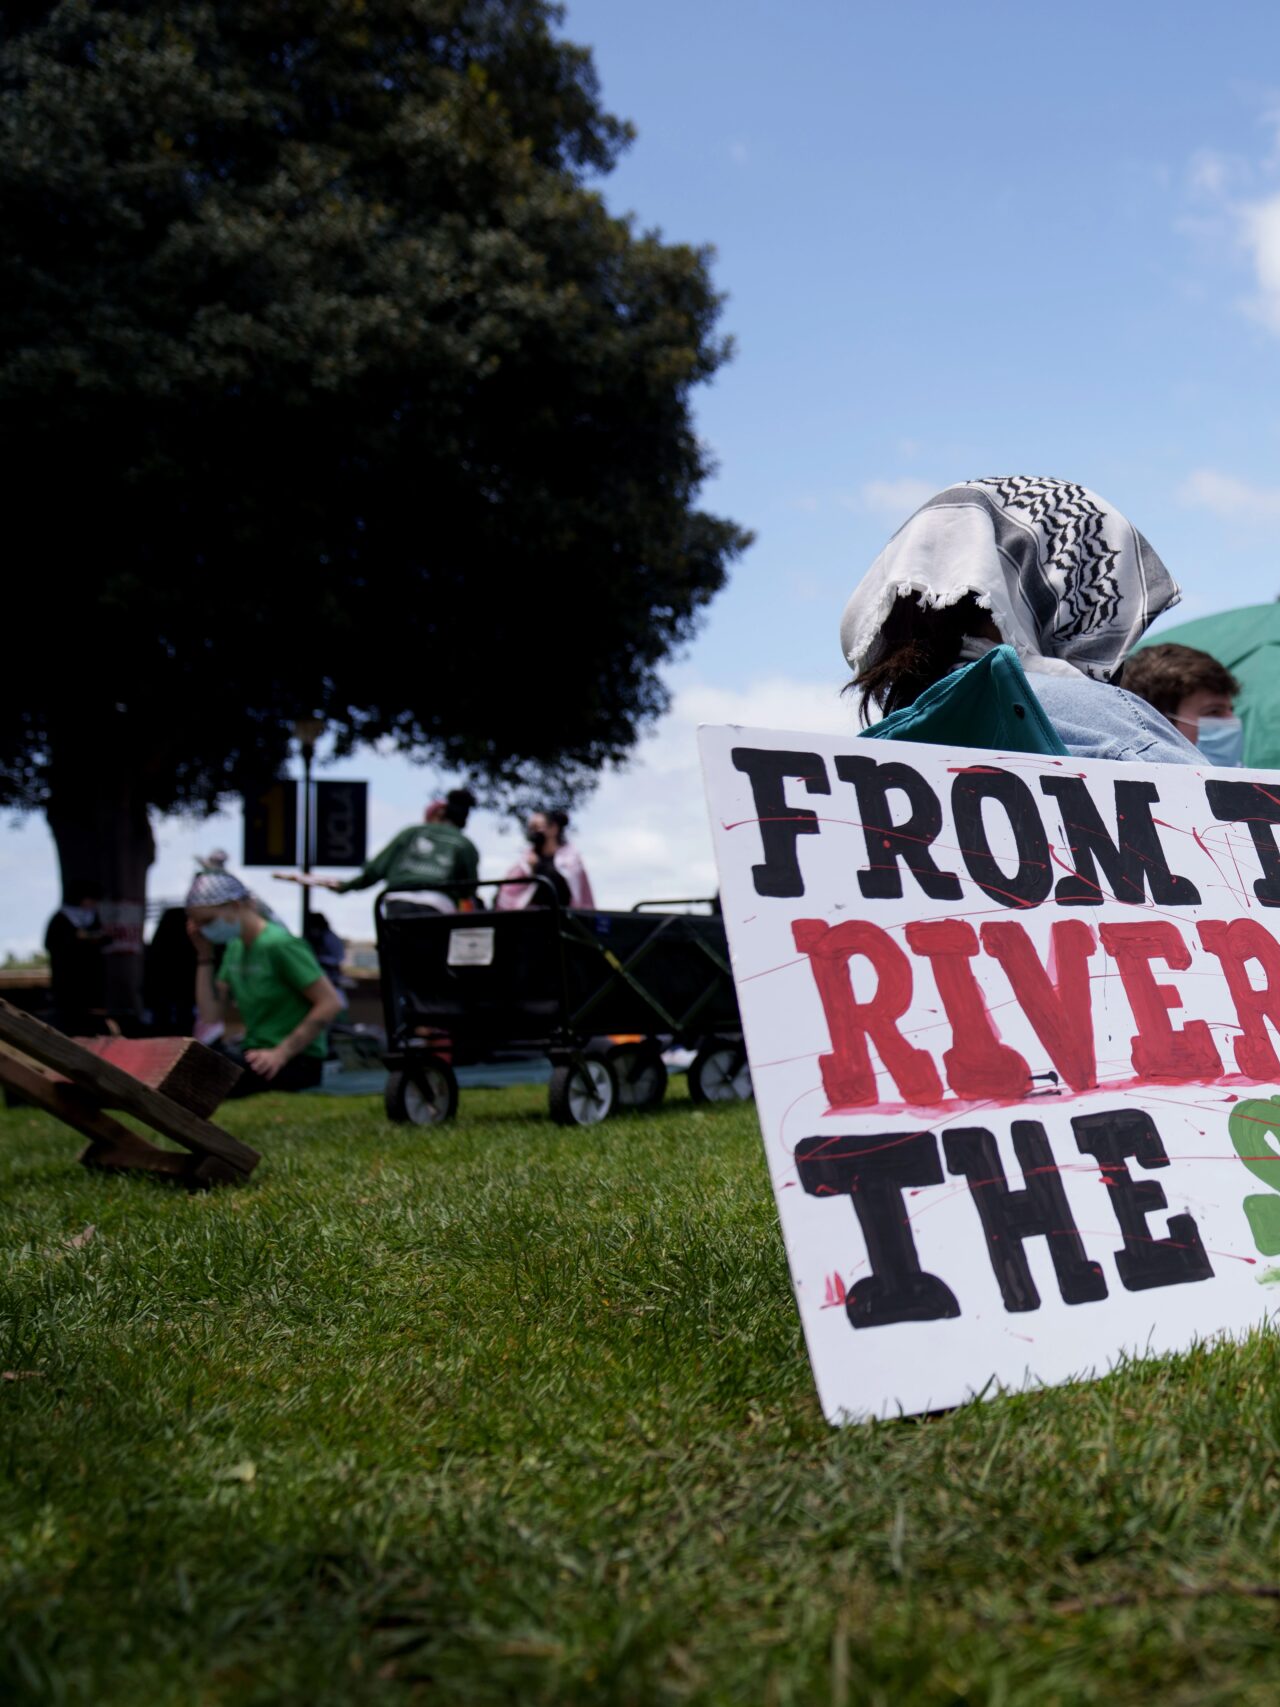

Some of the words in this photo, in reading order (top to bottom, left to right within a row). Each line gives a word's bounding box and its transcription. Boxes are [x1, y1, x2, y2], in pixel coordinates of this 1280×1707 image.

[327, 787, 354, 859] UCLA
[732, 747, 1201, 908] FROM
[795, 1108, 1215, 1328] THE
